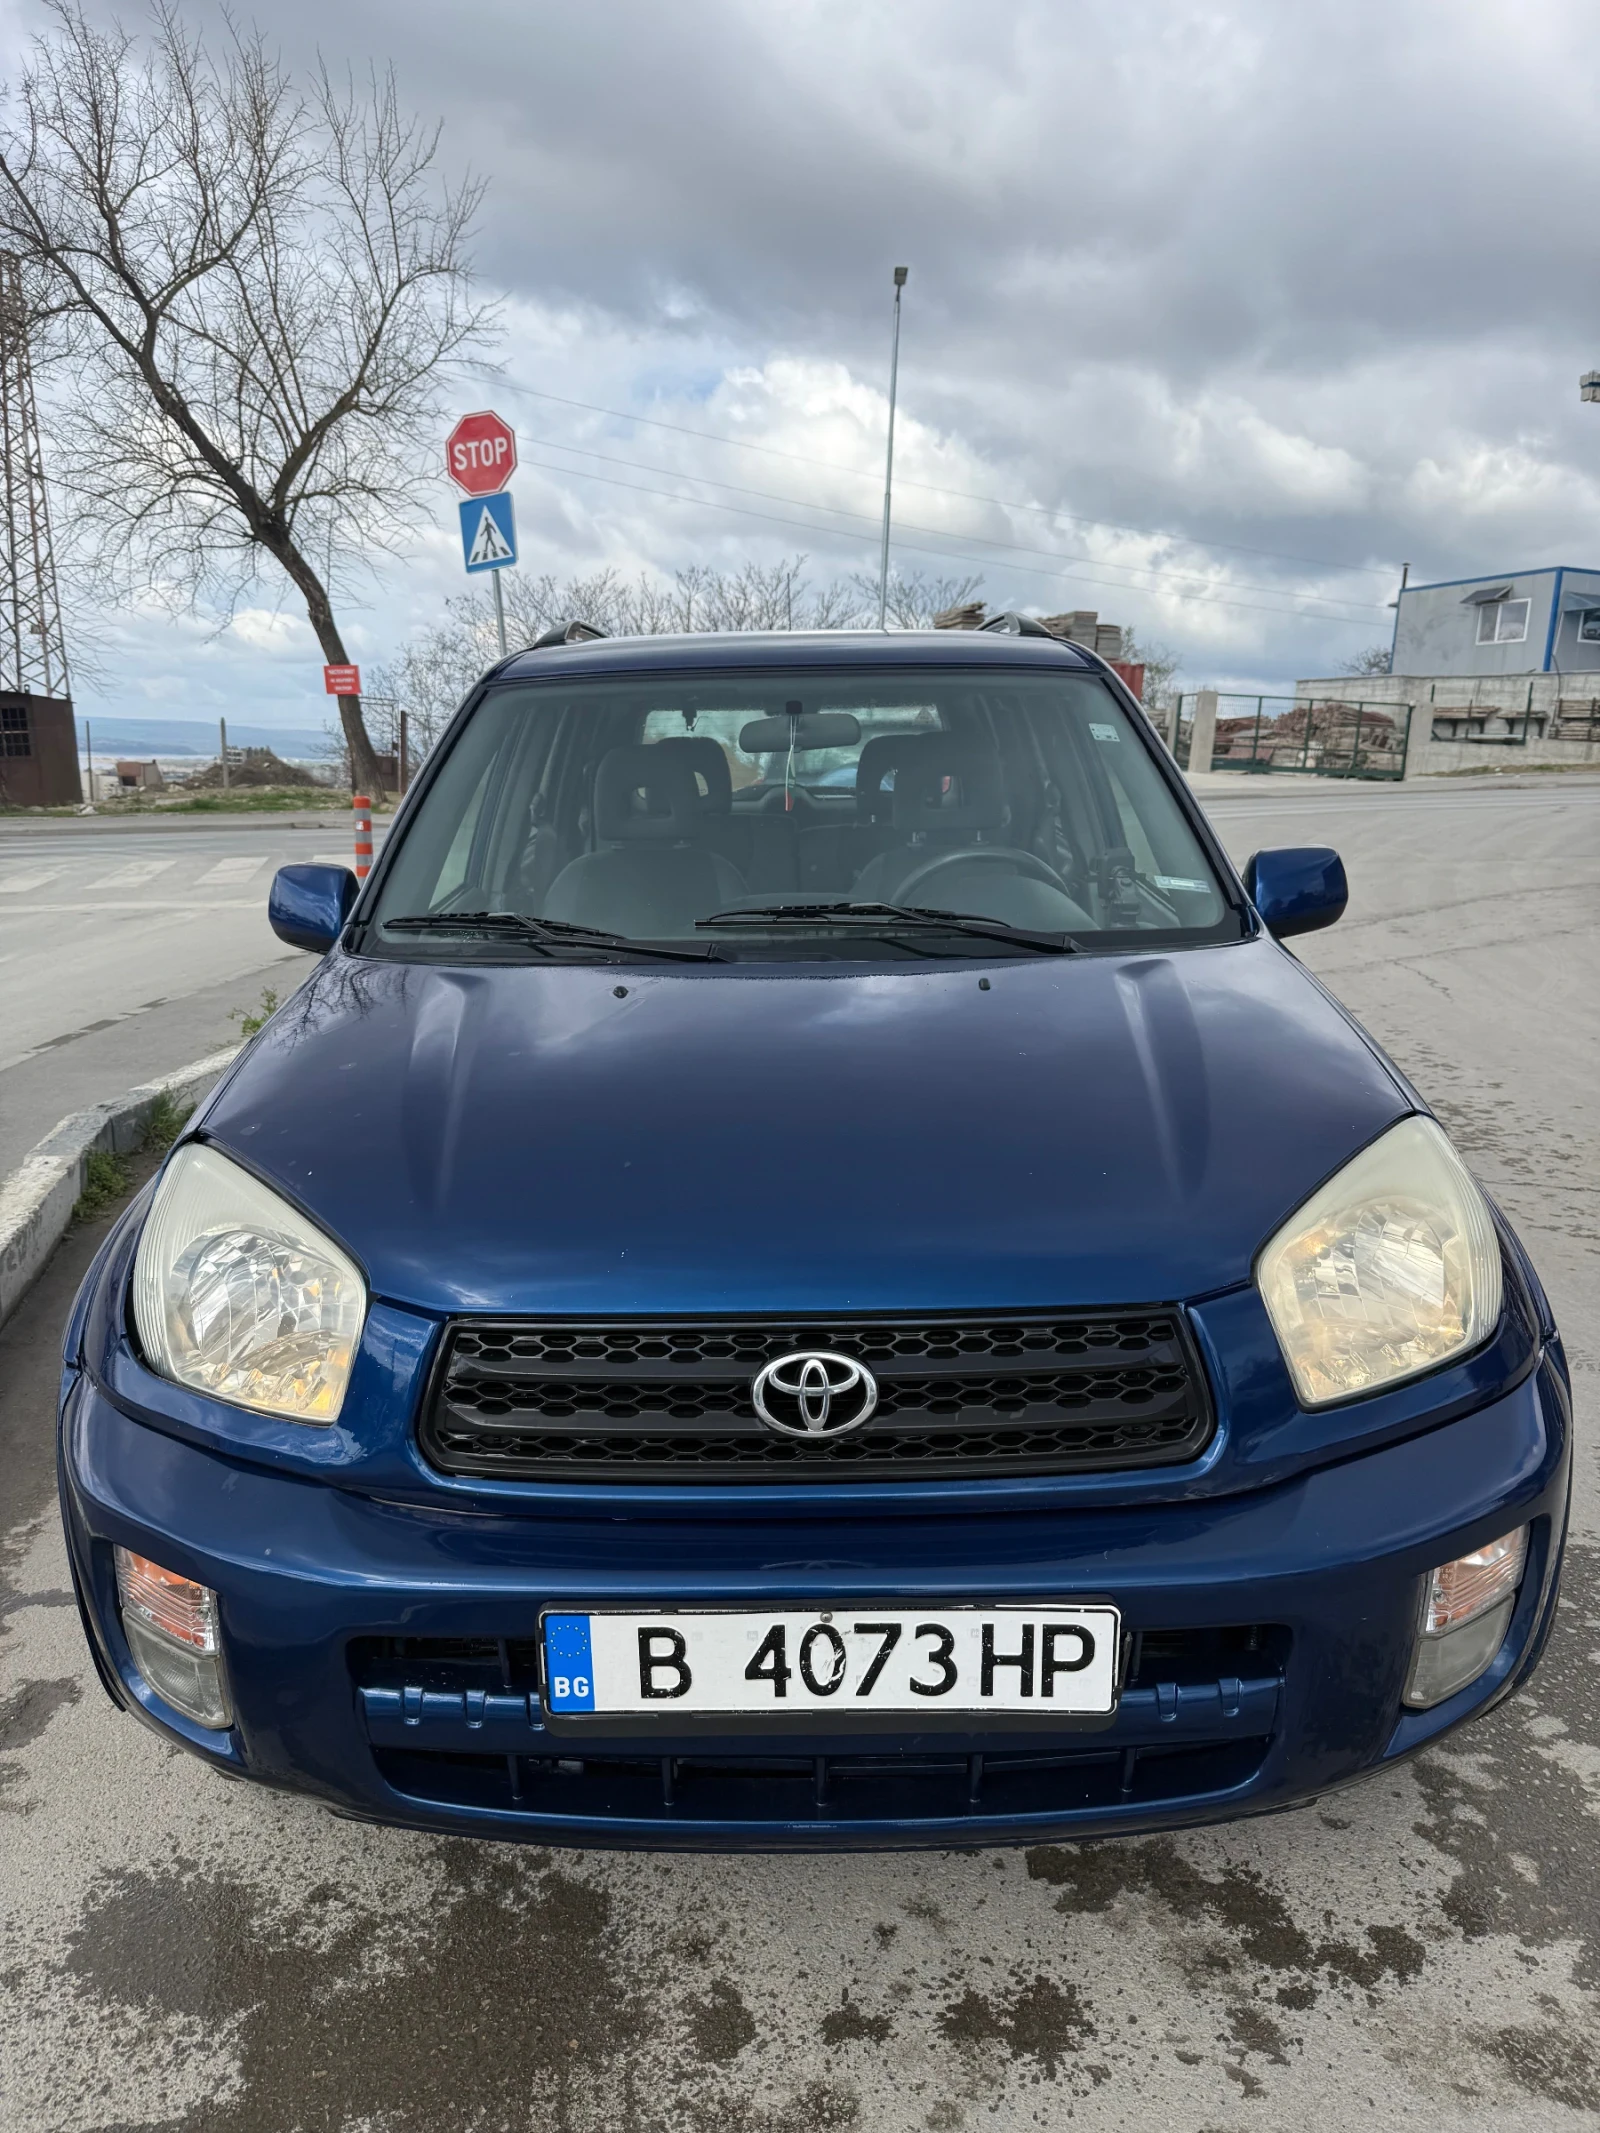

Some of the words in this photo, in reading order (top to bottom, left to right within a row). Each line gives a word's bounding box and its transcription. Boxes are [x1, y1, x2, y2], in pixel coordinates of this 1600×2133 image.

[453, 436, 508, 471] STOP
[637, 1626, 692, 1699] B
[744, 1623, 958, 1698] 4073
[553, 1676, 590, 1698] BG
